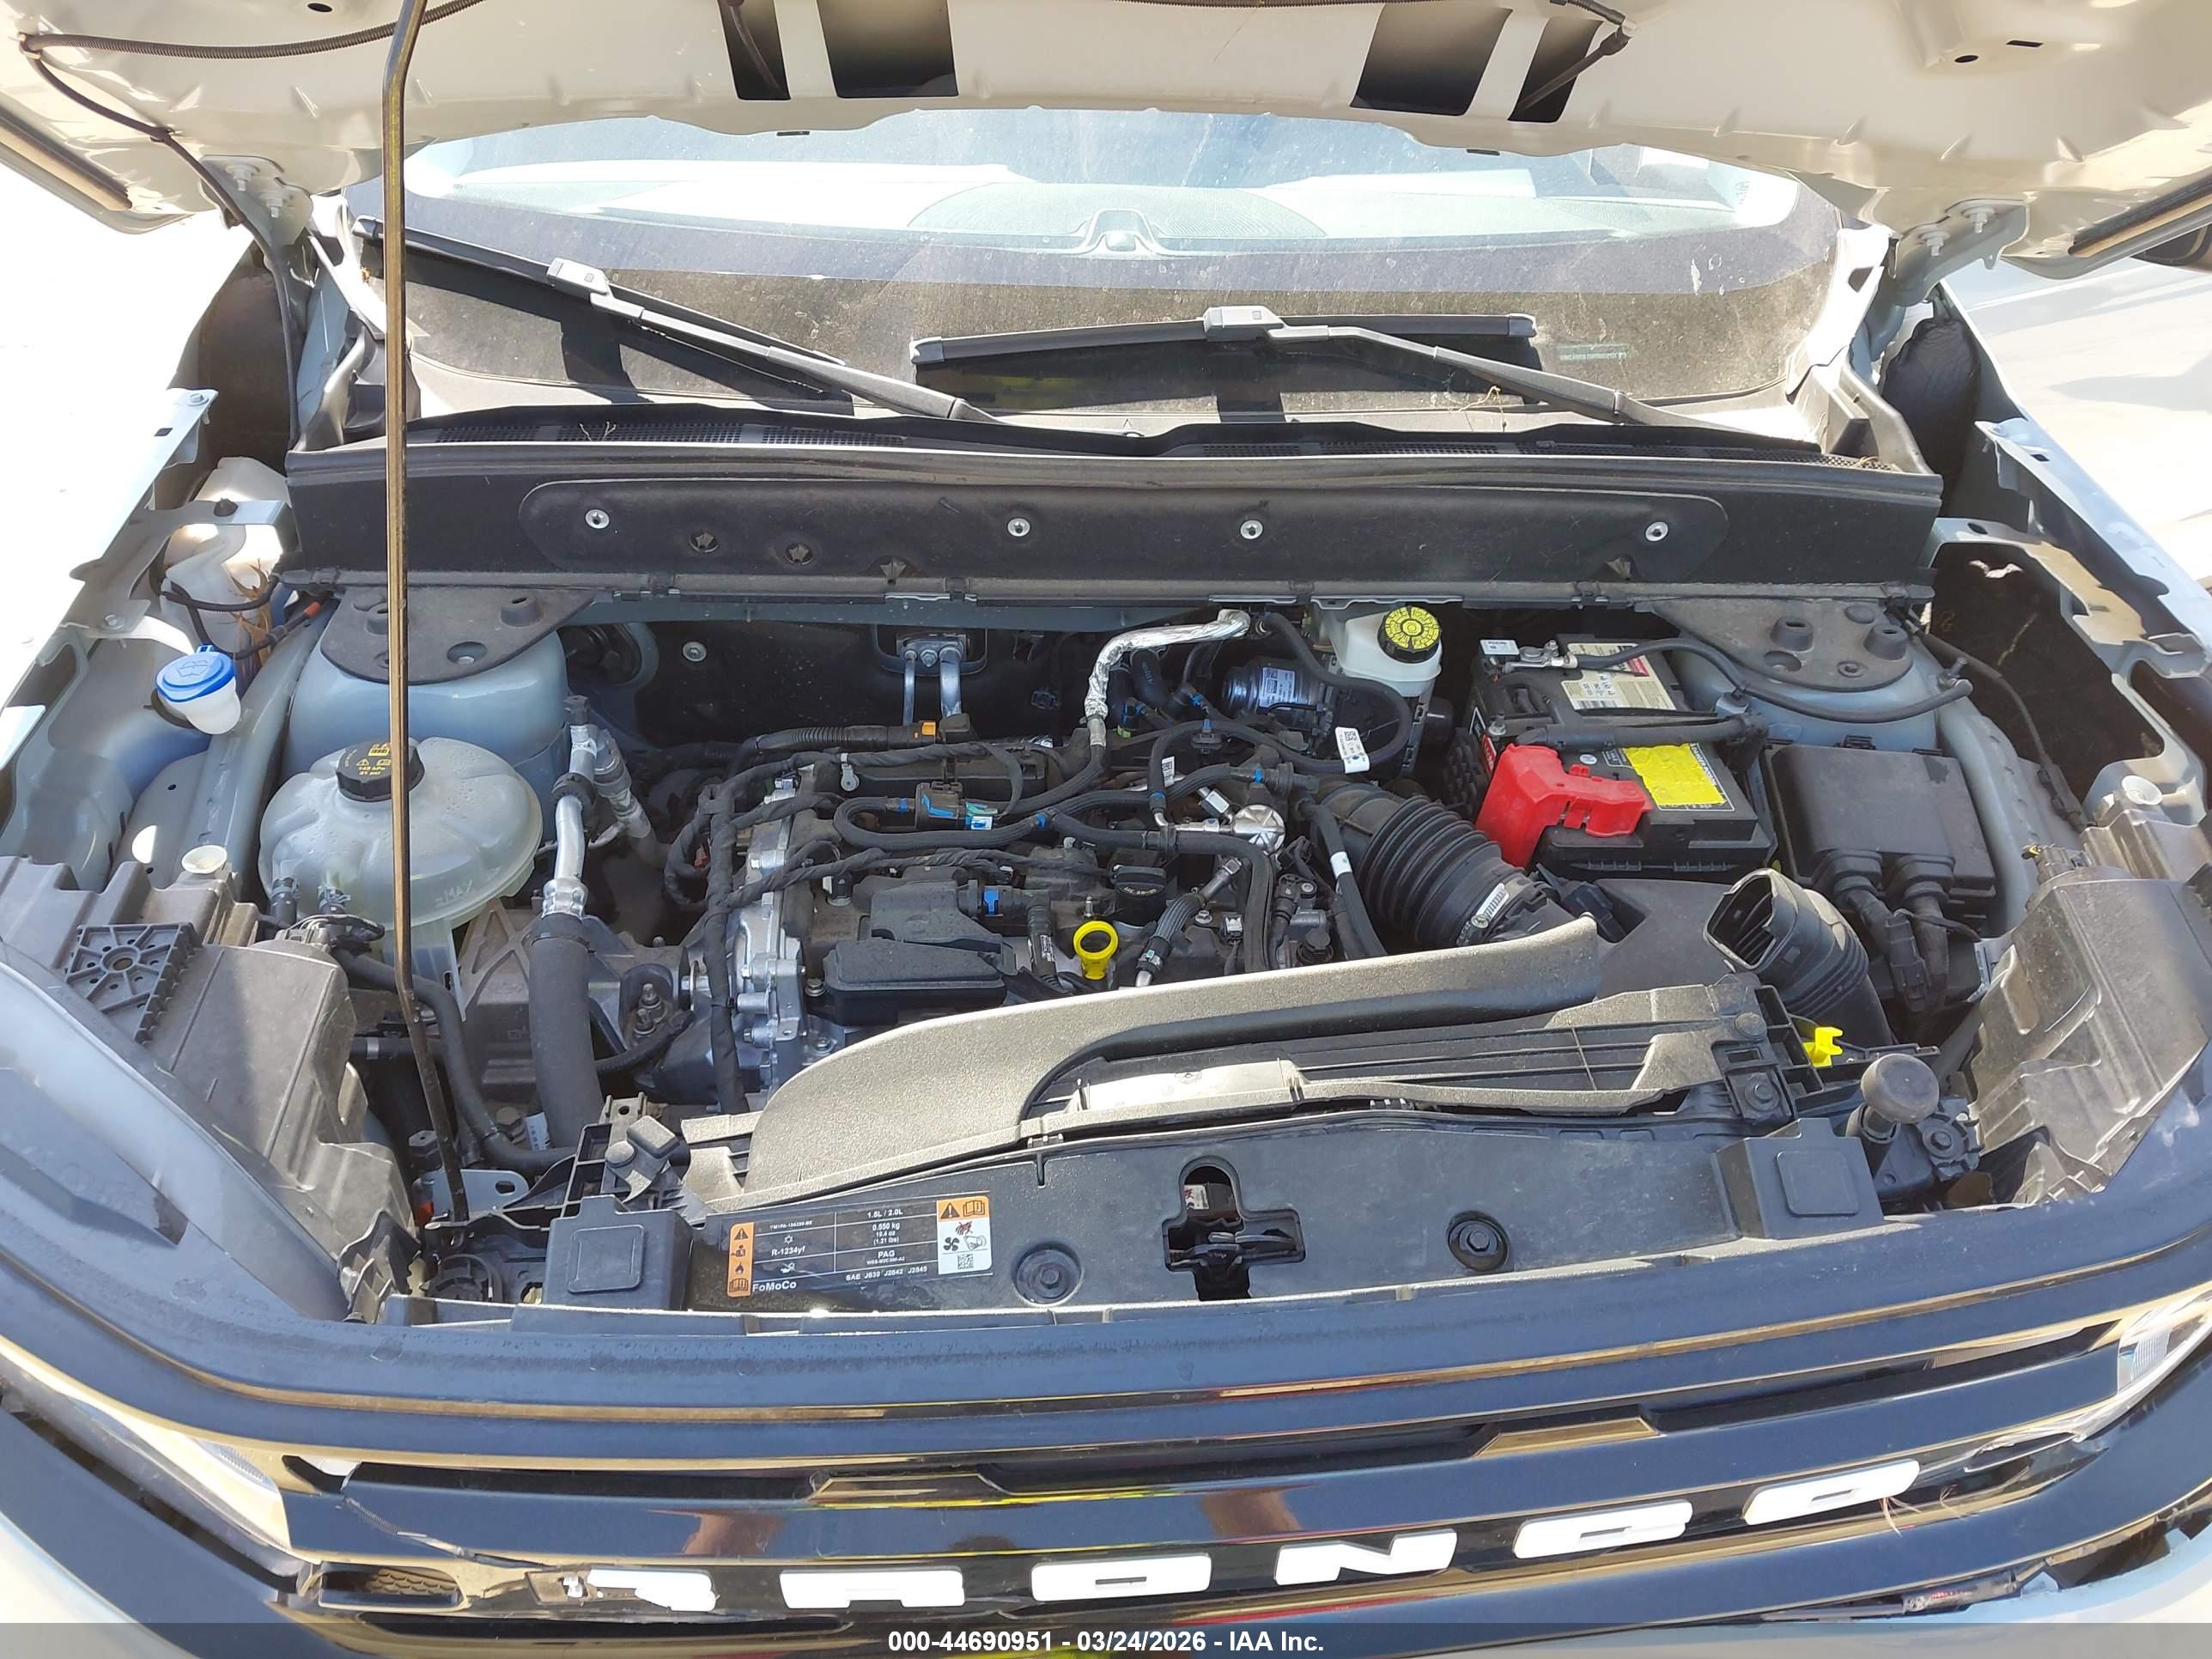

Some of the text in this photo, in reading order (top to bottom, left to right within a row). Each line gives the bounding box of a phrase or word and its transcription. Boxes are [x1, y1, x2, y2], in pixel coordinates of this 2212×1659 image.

[888, 1208, 904, 1217] 2.0L
[872, 1222, 901, 1231] 0.550 kg
[771, 1245, 806, 1258] R-1234yf
[878, 1249, 896, 1259] PAG
[752, 1280, 798, 1293] FoMoCo
